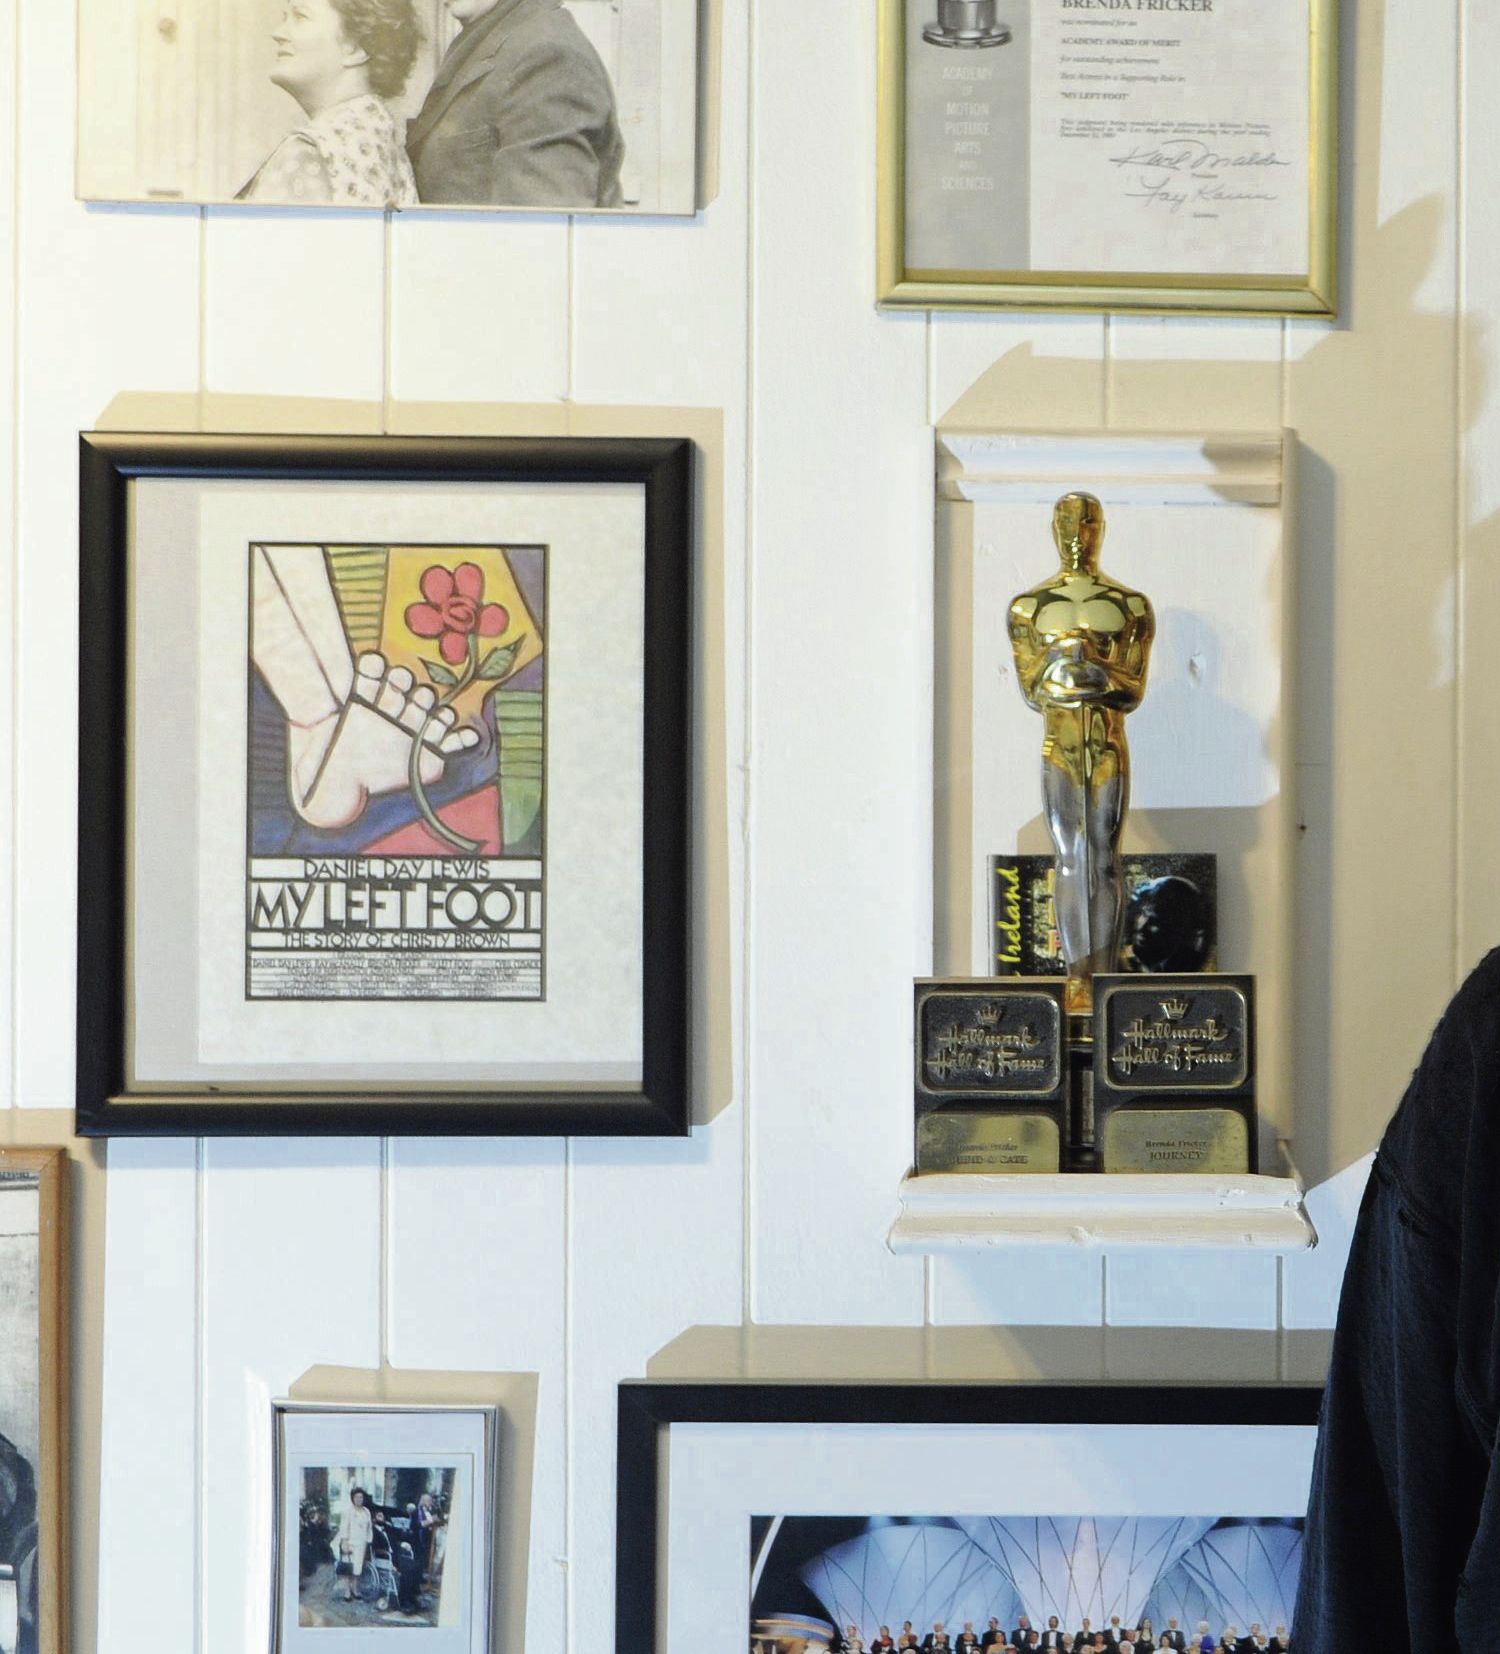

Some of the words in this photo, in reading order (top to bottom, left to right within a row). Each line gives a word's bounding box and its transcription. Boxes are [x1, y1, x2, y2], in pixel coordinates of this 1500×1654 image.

[1062, 0, 1132, 10] BRENDA
[1137, 0, 1213, 11] FRICKER
[304, 859, 376, 880] DANIEL
[384, 859, 424, 880] DAY
[431, 859, 490, 880] LEWIS
[252, 881, 317, 929] MY
[324, 881, 417, 930] LEFT
[426, 881, 542, 930] FOOT
[996, 865, 1022, 963] Ireland
[282, 931, 310, 948] THE
[314, 932, 362, 948] STORY
[366, 932, 388, 948] OF
[390, 932, 450, 949] CHRISTY
[454, 932, 511, 949] BROWN
[936, 1024, 1041, 1053] Hallmark
[1120, 1018, 1229, 1050] Hallmark
[926, 1049, 974, 1079] Hall
[977, 1050, 994, 1078] of
[996, 1047, 1046, 1078] Fame
[1111, 1044, 1160, 1075] Hall
[1163, 1044, 1182, 1071] of
[1184, 1043, 1235, 1071] Fame
[1149, 1151, 1203, 1161] JOURNEY
